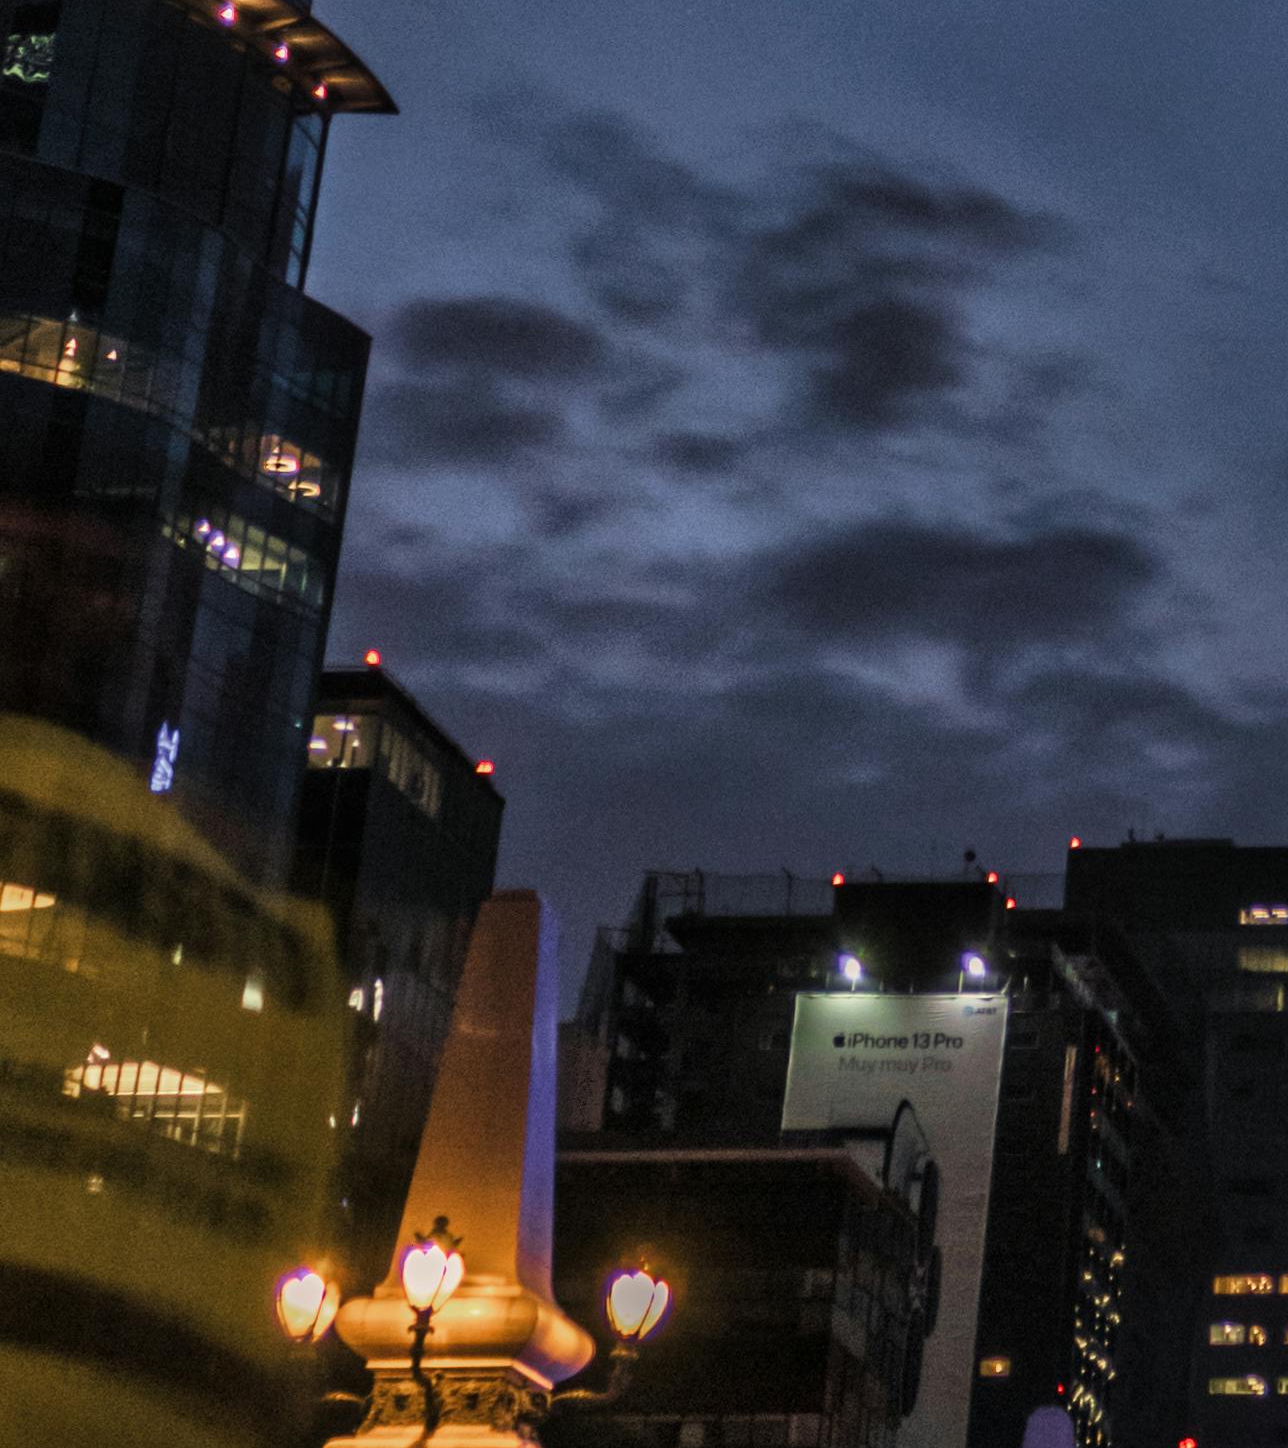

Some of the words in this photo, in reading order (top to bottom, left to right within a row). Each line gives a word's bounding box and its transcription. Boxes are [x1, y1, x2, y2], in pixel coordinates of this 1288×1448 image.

[848, 1032, 909, 1049] iPhone
[912, 1032, 930, 1049] 13
[933, 1031, 963, 1049] Pro
[838, 1056, 876, 1075] Muy
[880, 1059, 919, 1075] muy
[922, 1056, 953, 1072] Pro
